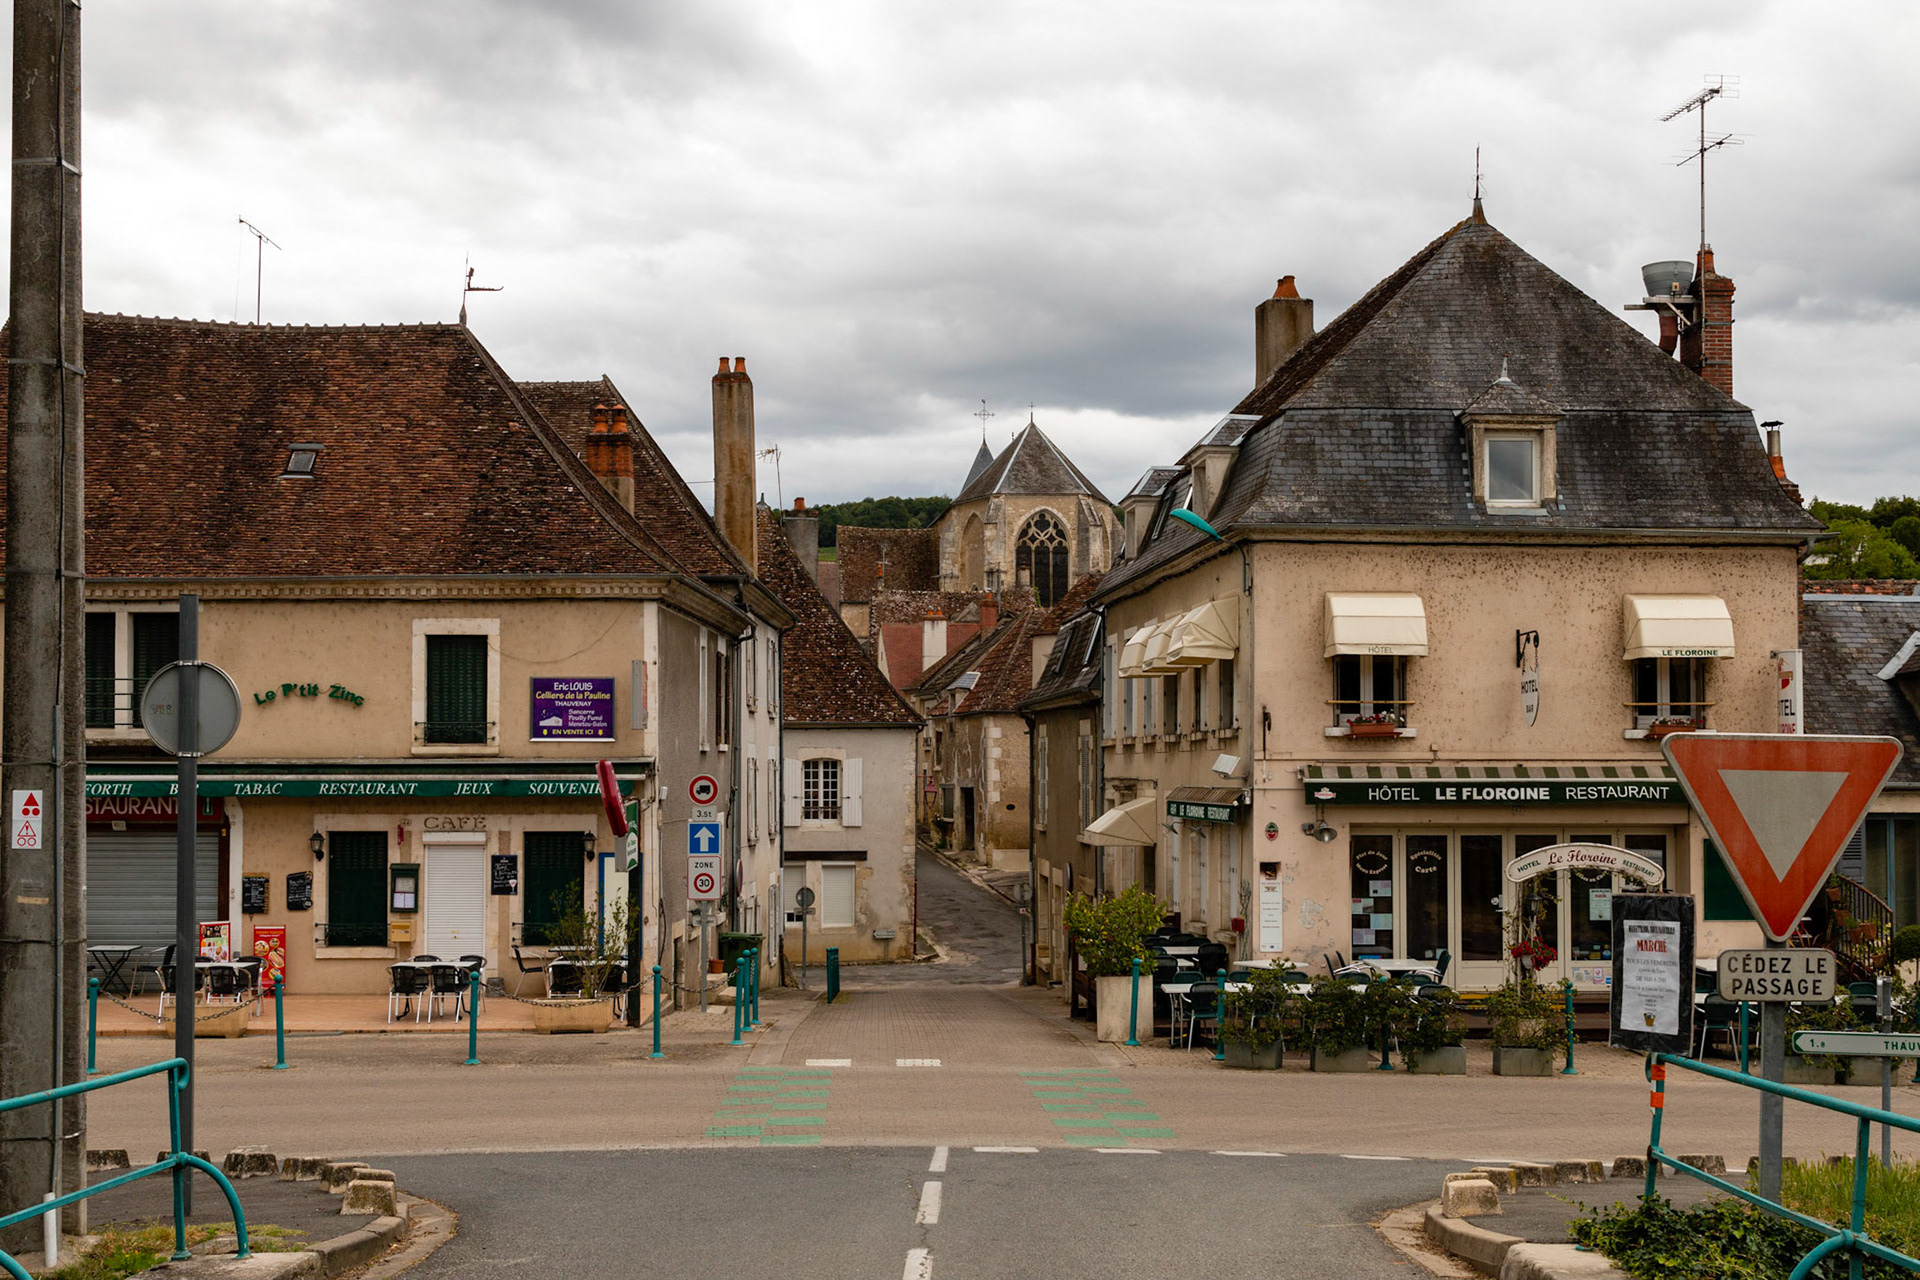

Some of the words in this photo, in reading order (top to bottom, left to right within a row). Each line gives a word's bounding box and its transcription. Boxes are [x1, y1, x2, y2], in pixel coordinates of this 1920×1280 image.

[1368, 646, 1394, 654] HÔTEL
[553, 682, 570, 691] Eric
[570, 682, 593, 691] LOUIS
[1521, 680, 1538, 694] HOTEL
[253, 690, 277, 706] Le
[281, 683, 319, 697] P'tit
[328, 683, 365, 706] Zinc
[535, 691, 565, 700] Celliers
[565, 691, 575, 700] de
[576, 691, 583, 700] la
[584, 691, 611, 700] Pauline
[1526, 704, 1534, 713] BAR
[1779, 698, 1795, 716] TEL
[234, 783, 282, 795] TABAC
[319, 782, 418, 795] RESTAURANT
[453, 782, 494, 796] JEUX
[1368, 785, 1420, 801] HÔTEL
[1435, 787, 1457, 801] LE
[1462, 786, 1550, 801] FLOROINE
[1565, 786, 1670, 800] RESTAURANT
[696, 810, 712, 818] 3.5t
[423, 815, 487, 830] CAFÉ
[1415, 865, 1437, 874] Carte
[1517, 860, 1541, 873] HOTEL
[1547, 852, 1564, 865] Le
[1566, 850, 1618, 866] Floroine
[1622, 859, 1656, 878] RESTAURANT
[698, 879, 710, 887] 30
[1637, 938, 1667, 953] MARCHÉ
[1727, 953, 1792, 974] CÉDEZ
[1806, 957, 1827, 974] LE
[1732, 978, 1823, 996] PASSAGE
[1810, 1039, 1825, 1048] 1.8
